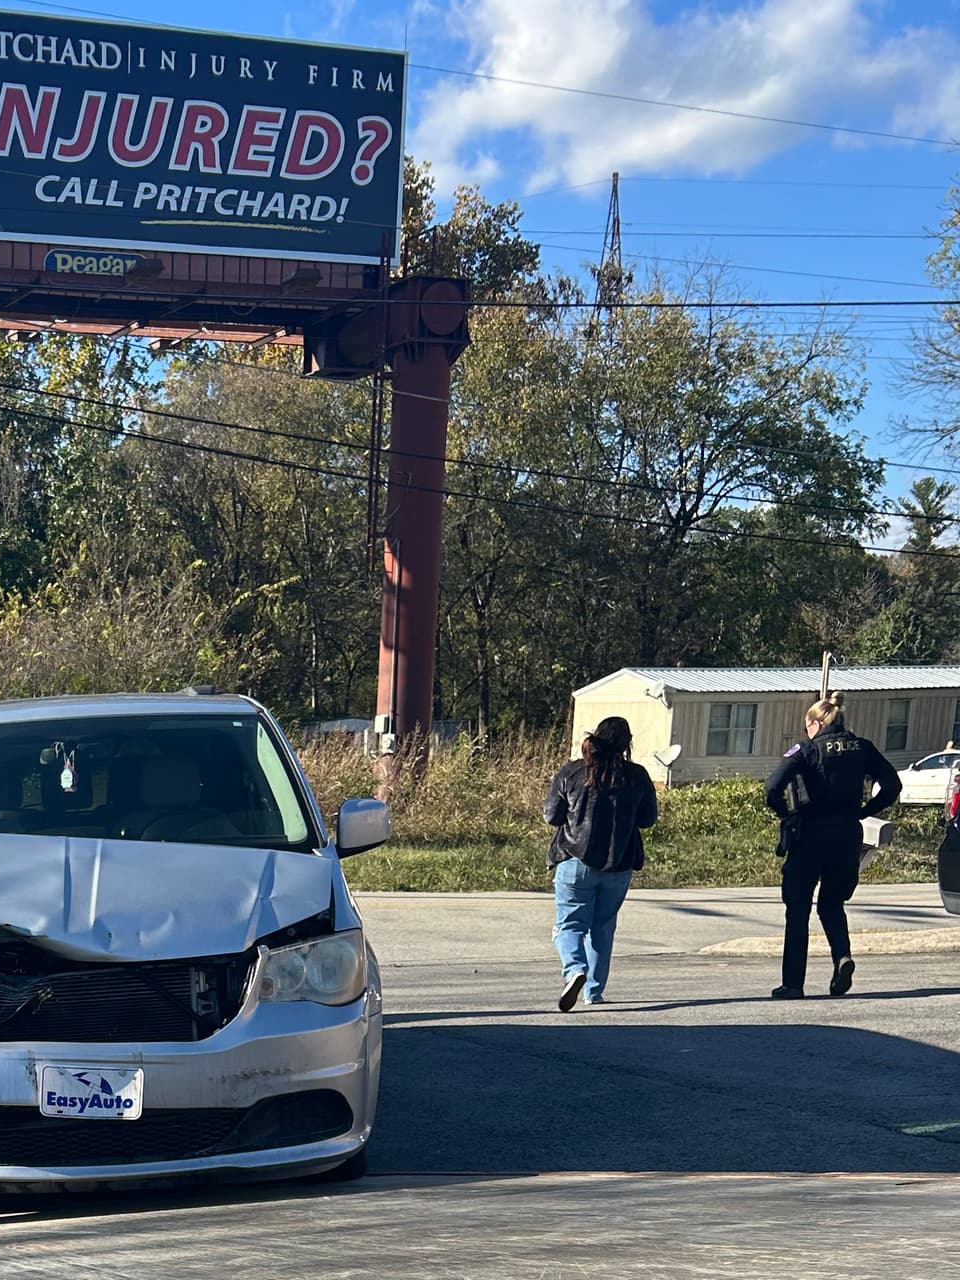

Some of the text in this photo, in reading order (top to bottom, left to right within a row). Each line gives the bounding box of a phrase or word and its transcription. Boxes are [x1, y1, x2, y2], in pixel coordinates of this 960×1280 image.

[137, 47, 279, 81] INJURY
[307, 64, 395, 92] FIRM
[34, 175, 350, 223] CALL PRITCHARD!
[825, 741, 861, 753] POLICE
[46, 1091, 134, 1114] EasyAuto
